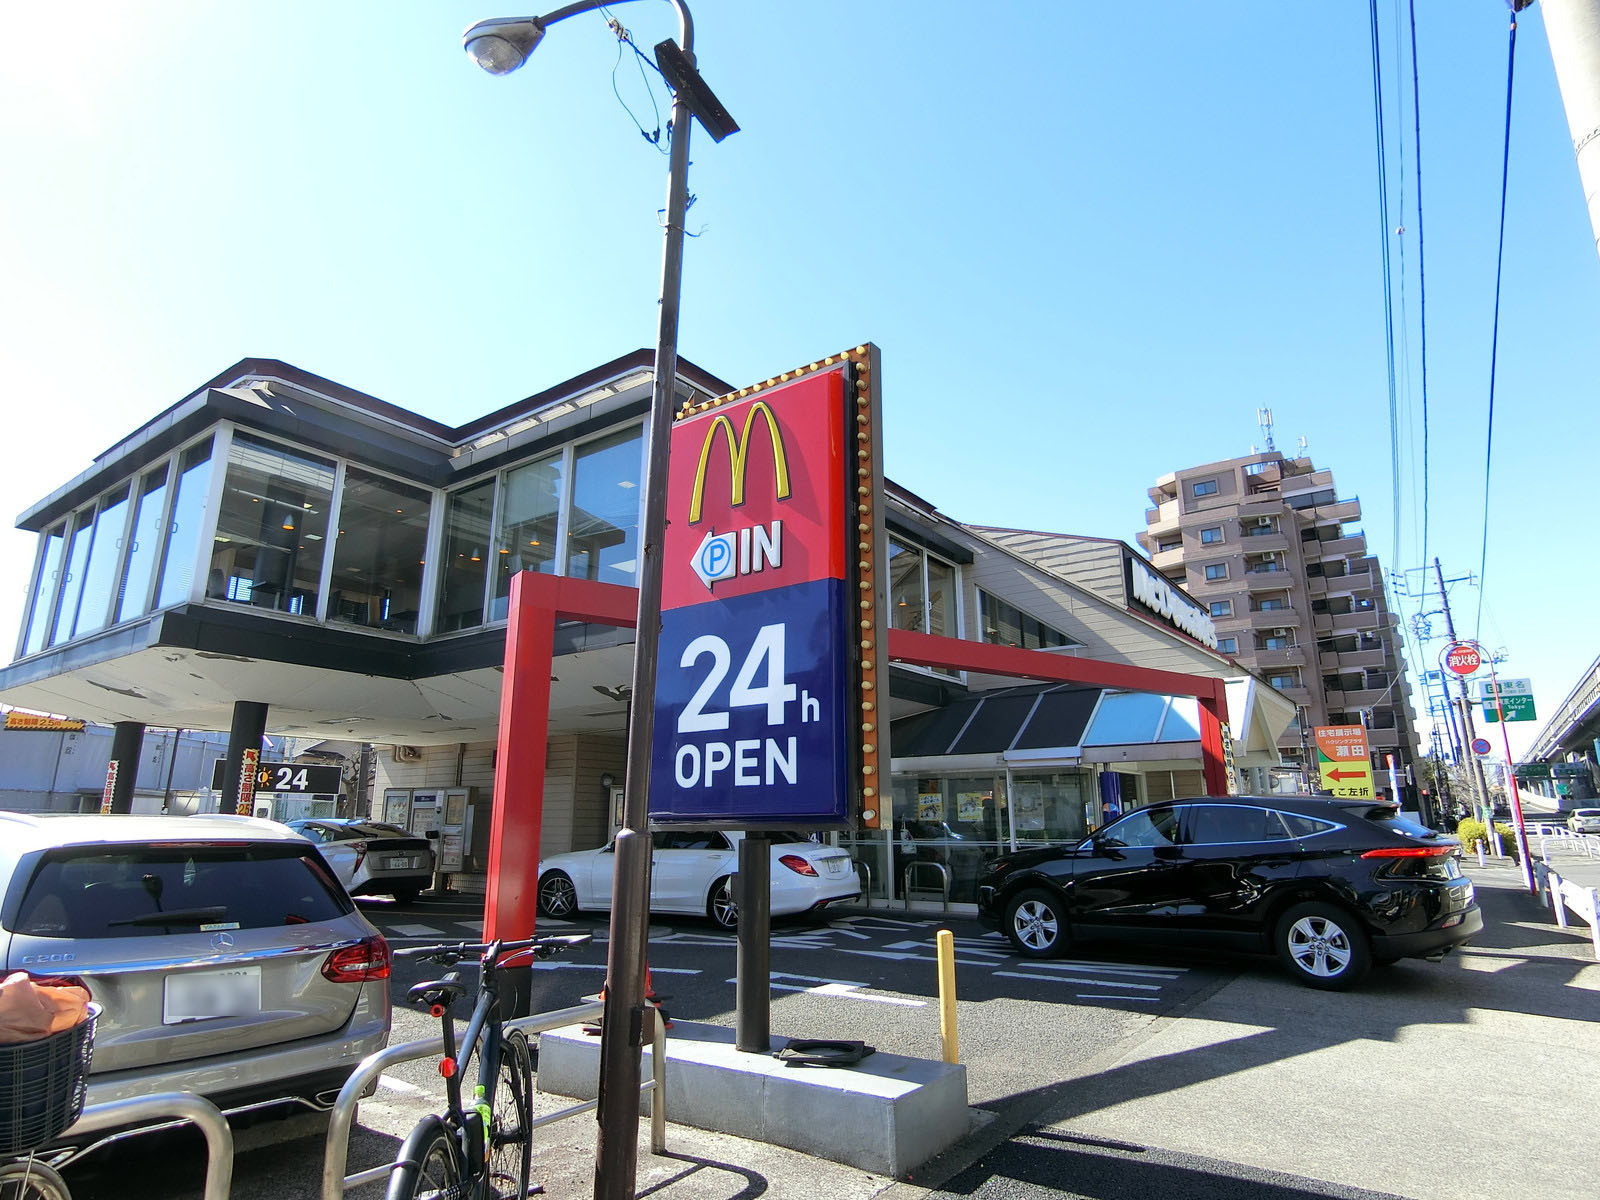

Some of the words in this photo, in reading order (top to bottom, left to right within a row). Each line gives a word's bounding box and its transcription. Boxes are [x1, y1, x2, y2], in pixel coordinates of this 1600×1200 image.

[741, 520, 782, 575] IN
[1448, 654, 1479, 667] 消火栓
[675, 736, 797, 788] OPEN
[1336, 745, 1365, 757] 瀬田
[275, 767, 309, 791] 24
